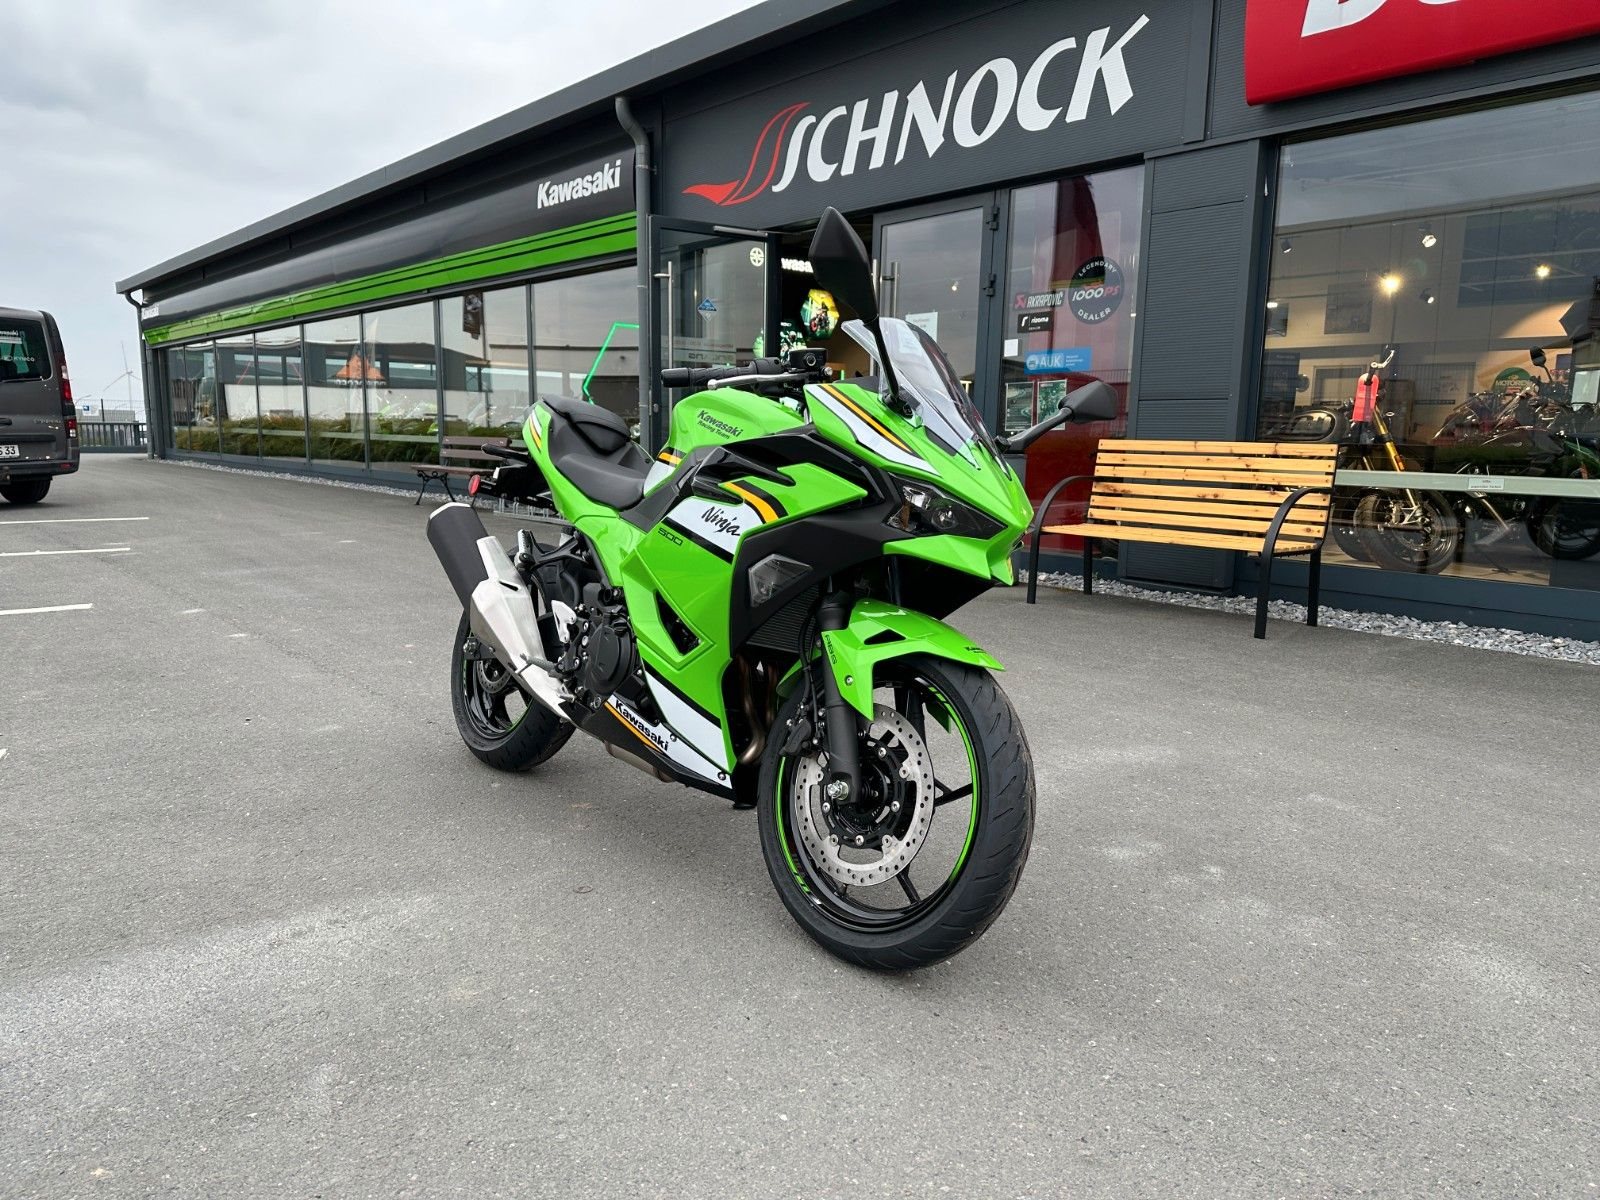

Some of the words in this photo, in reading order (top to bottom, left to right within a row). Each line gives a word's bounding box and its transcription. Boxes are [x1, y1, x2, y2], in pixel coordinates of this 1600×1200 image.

[771, 13, 1150, 193] SCHNOCK
[537, 159, 622, 209] Kawasaki
[1078, 260, 1117, 277] LEGENDARY
[1077, 307, 1112, 321] DEALER
[1040, 354, 1060, 367] AUK
[697, 410, 744, 437] Kawasaki
[697, 420, 716, 433] Racing
[715, 428, 730, 440] Team
[701, 506, 741, 536] Ninja
[658, 527, 683, 547] 500
[825, 634, 838, 665] ABS
[615, 699, 669, 752] Kawasaki
